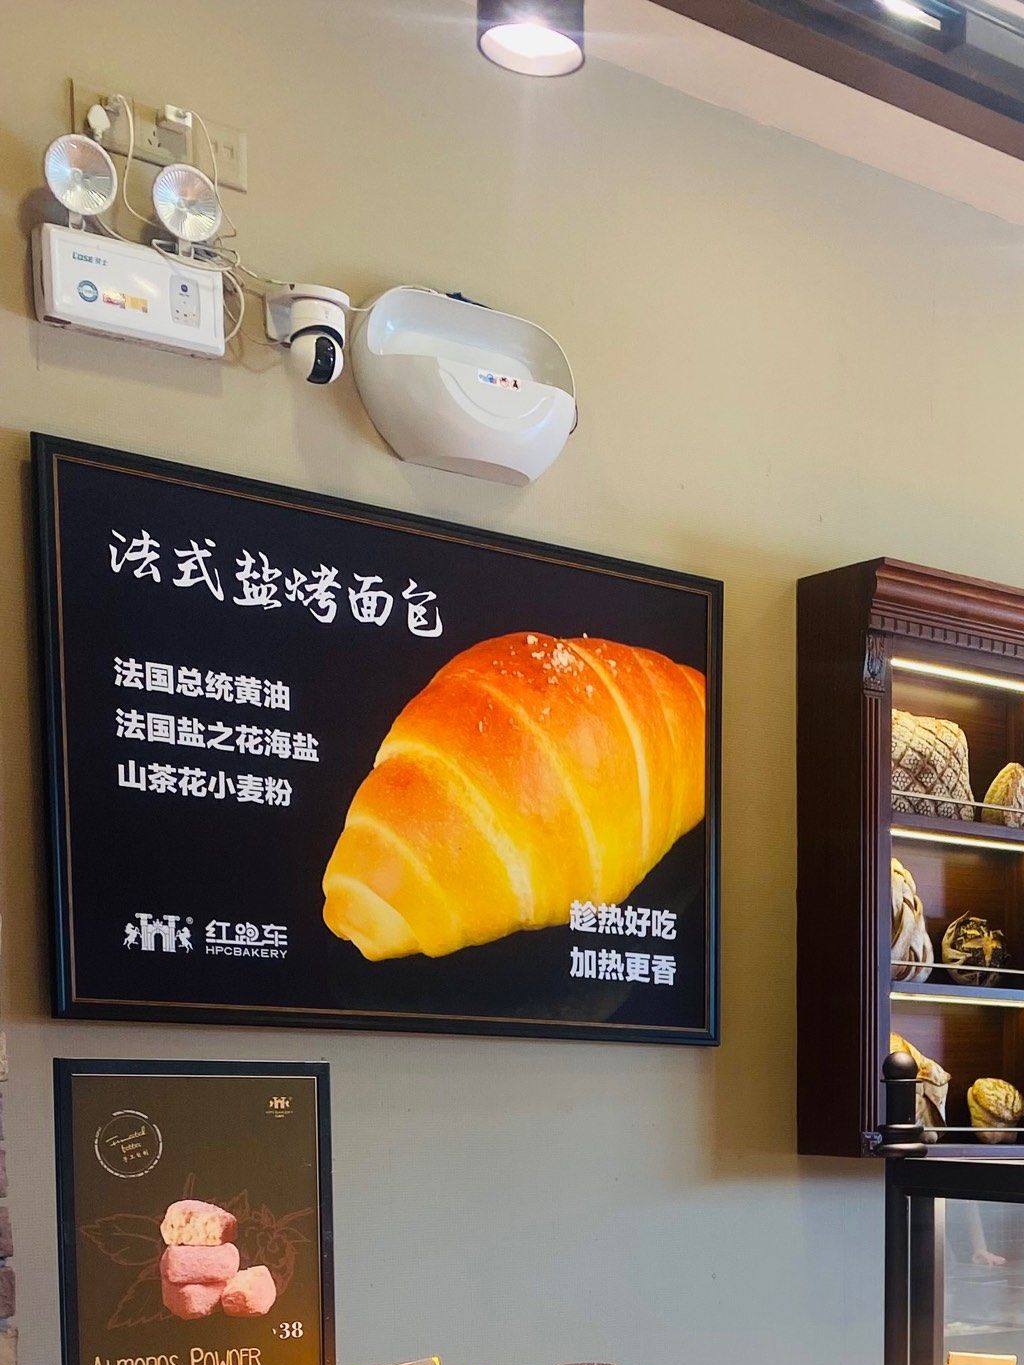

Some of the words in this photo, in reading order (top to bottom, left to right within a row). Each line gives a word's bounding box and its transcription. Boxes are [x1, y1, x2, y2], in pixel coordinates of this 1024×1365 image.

[109, 528, 444, 638] 法式盐烤面包
[113, 657, 291, 711] 法国总统黄油
[115, 709, 320, 763] 法国盐之花海盐
[118, 761, 293, 807] 山茶花小麦粉
[205, 920, 288, 947] 红跑车
[569, 901, 677, 941] 趁热好吃
[205, 946, 288, 960] HPCBAKERY
[570, 948, 677, 986] 加热更香
